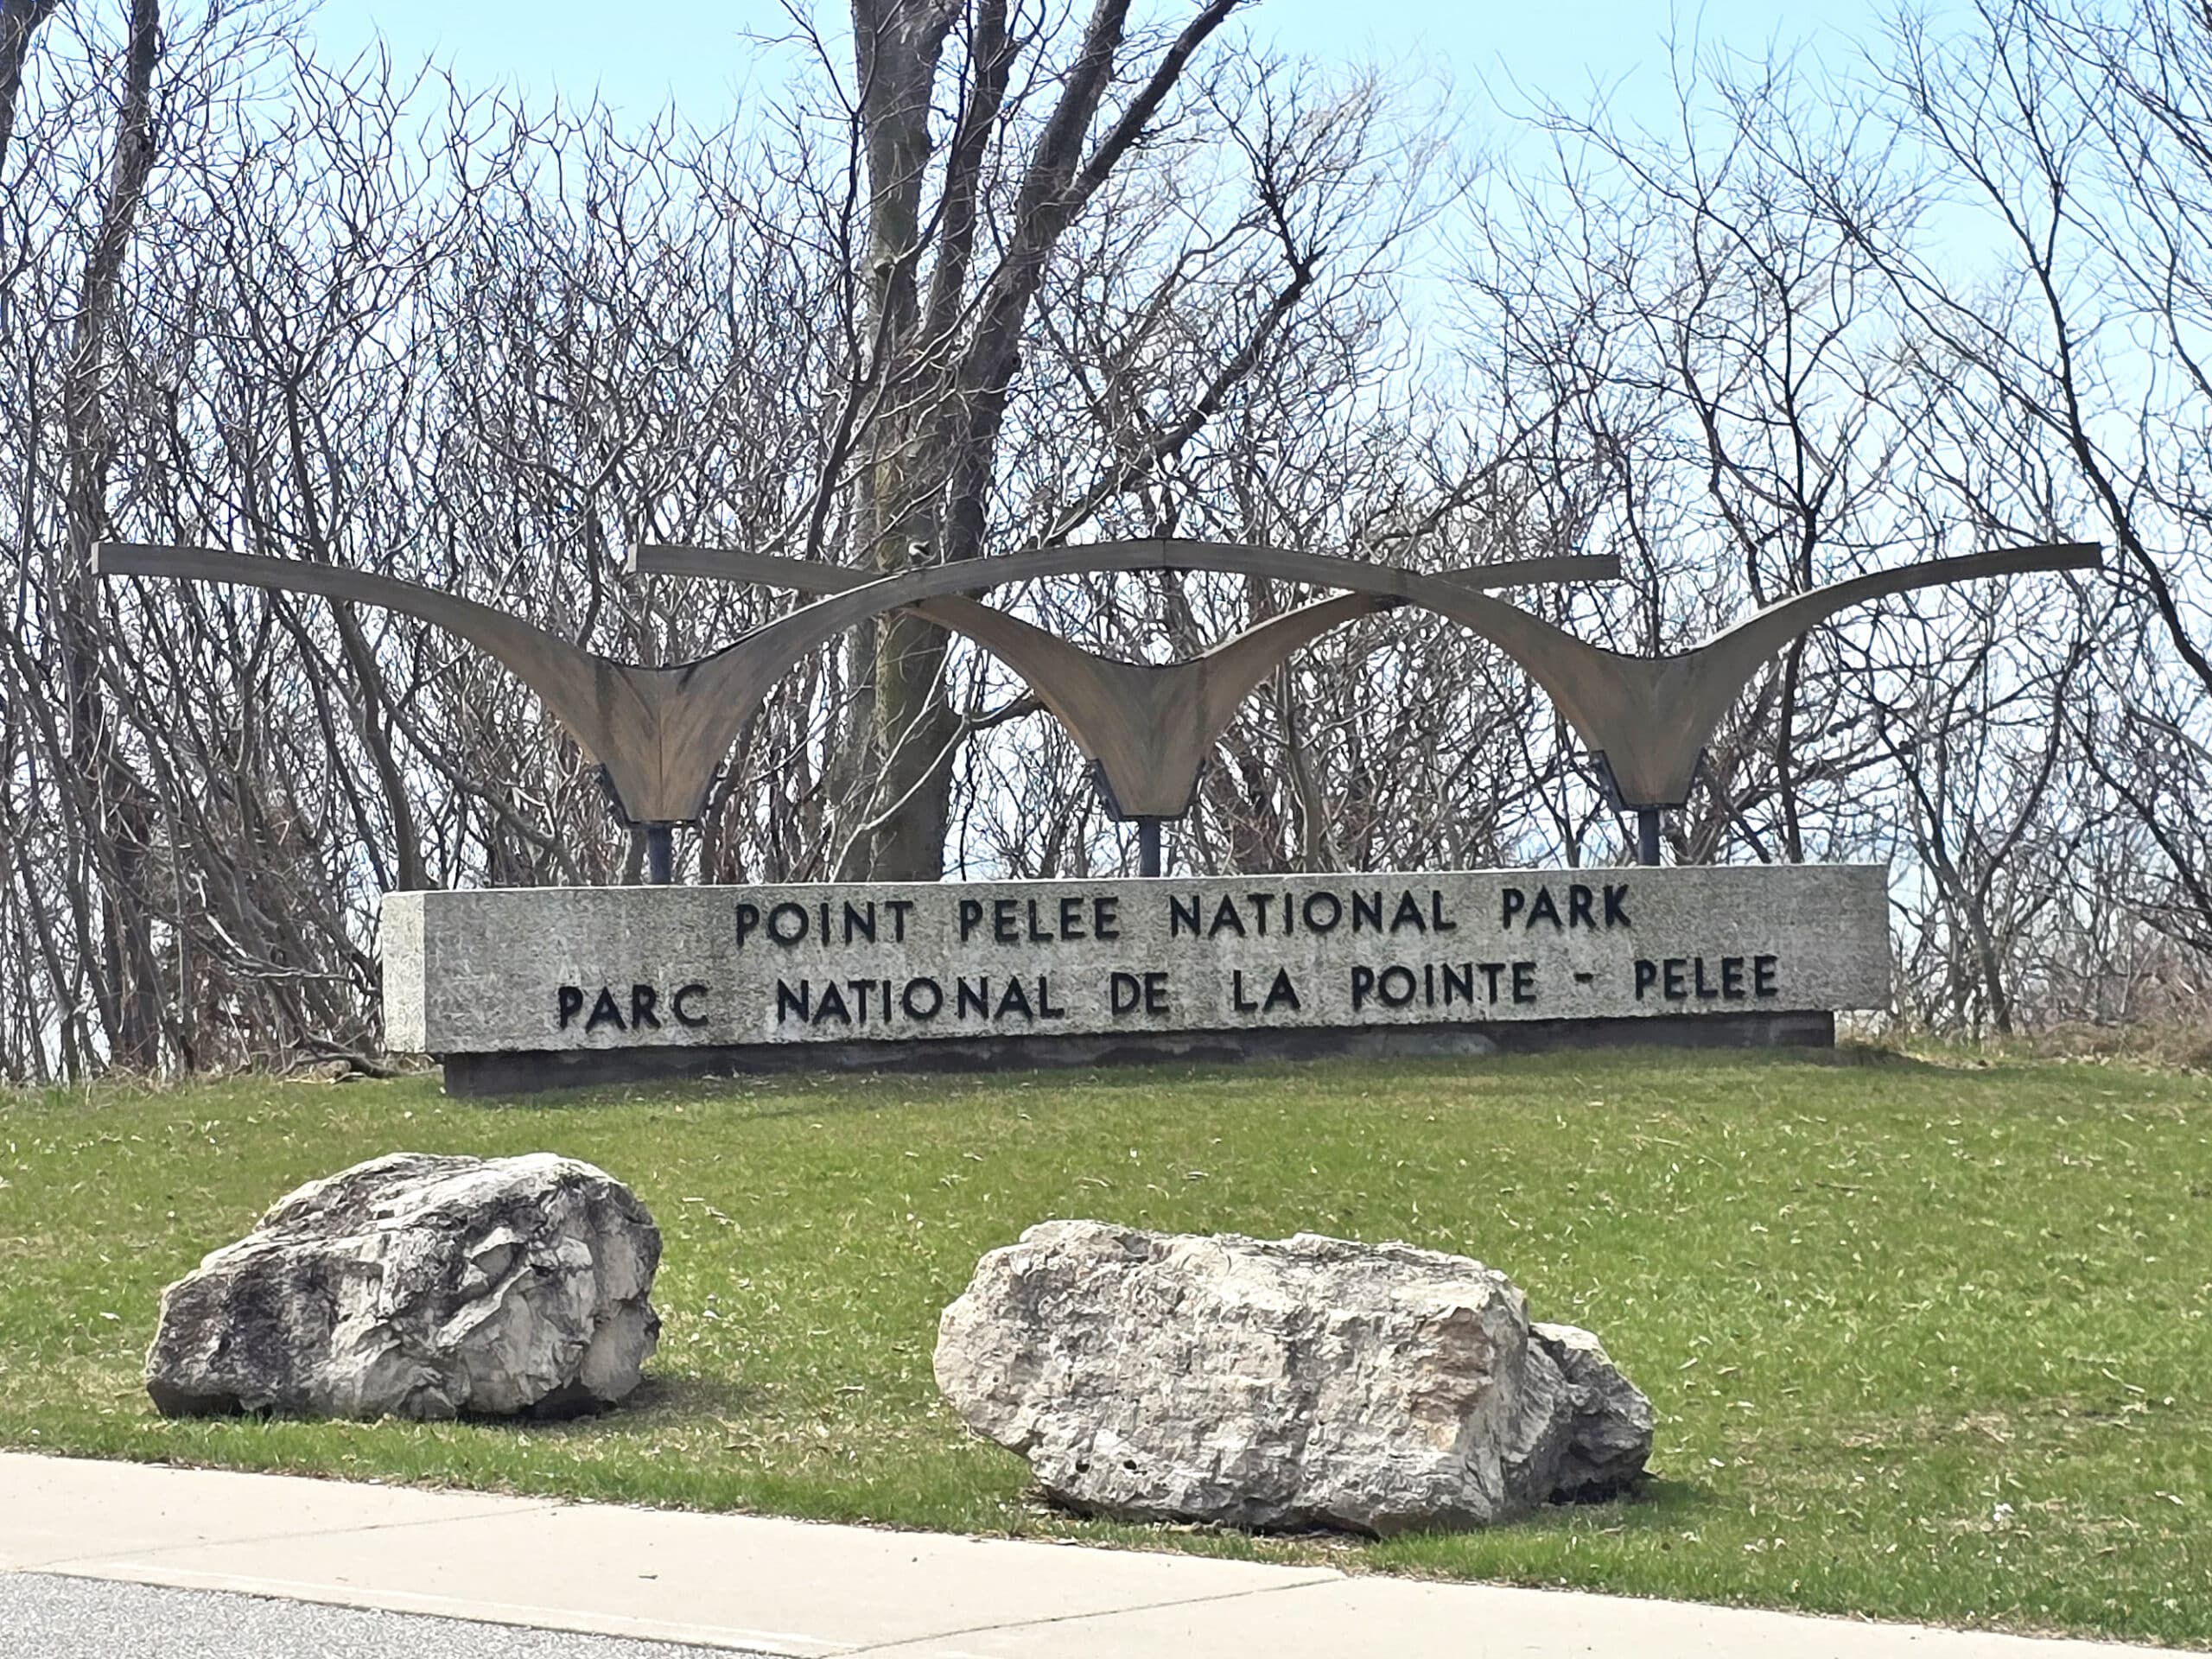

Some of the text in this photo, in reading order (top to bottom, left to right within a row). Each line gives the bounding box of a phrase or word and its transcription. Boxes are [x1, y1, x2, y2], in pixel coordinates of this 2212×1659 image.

[736, 884, 1631, 946] POINT PELEE NATIONAL PARK
[558, 983, 708, 1033] PARC
[778, 976, 1064, 1025] NATIONAL
[1111, 971, 1169, 1014] DE
[1234, 967, 1300, 1012] LA
[1352, 962, 1537, 1007] POINTE
[1635, 955, 1778, 1000] PELEE
